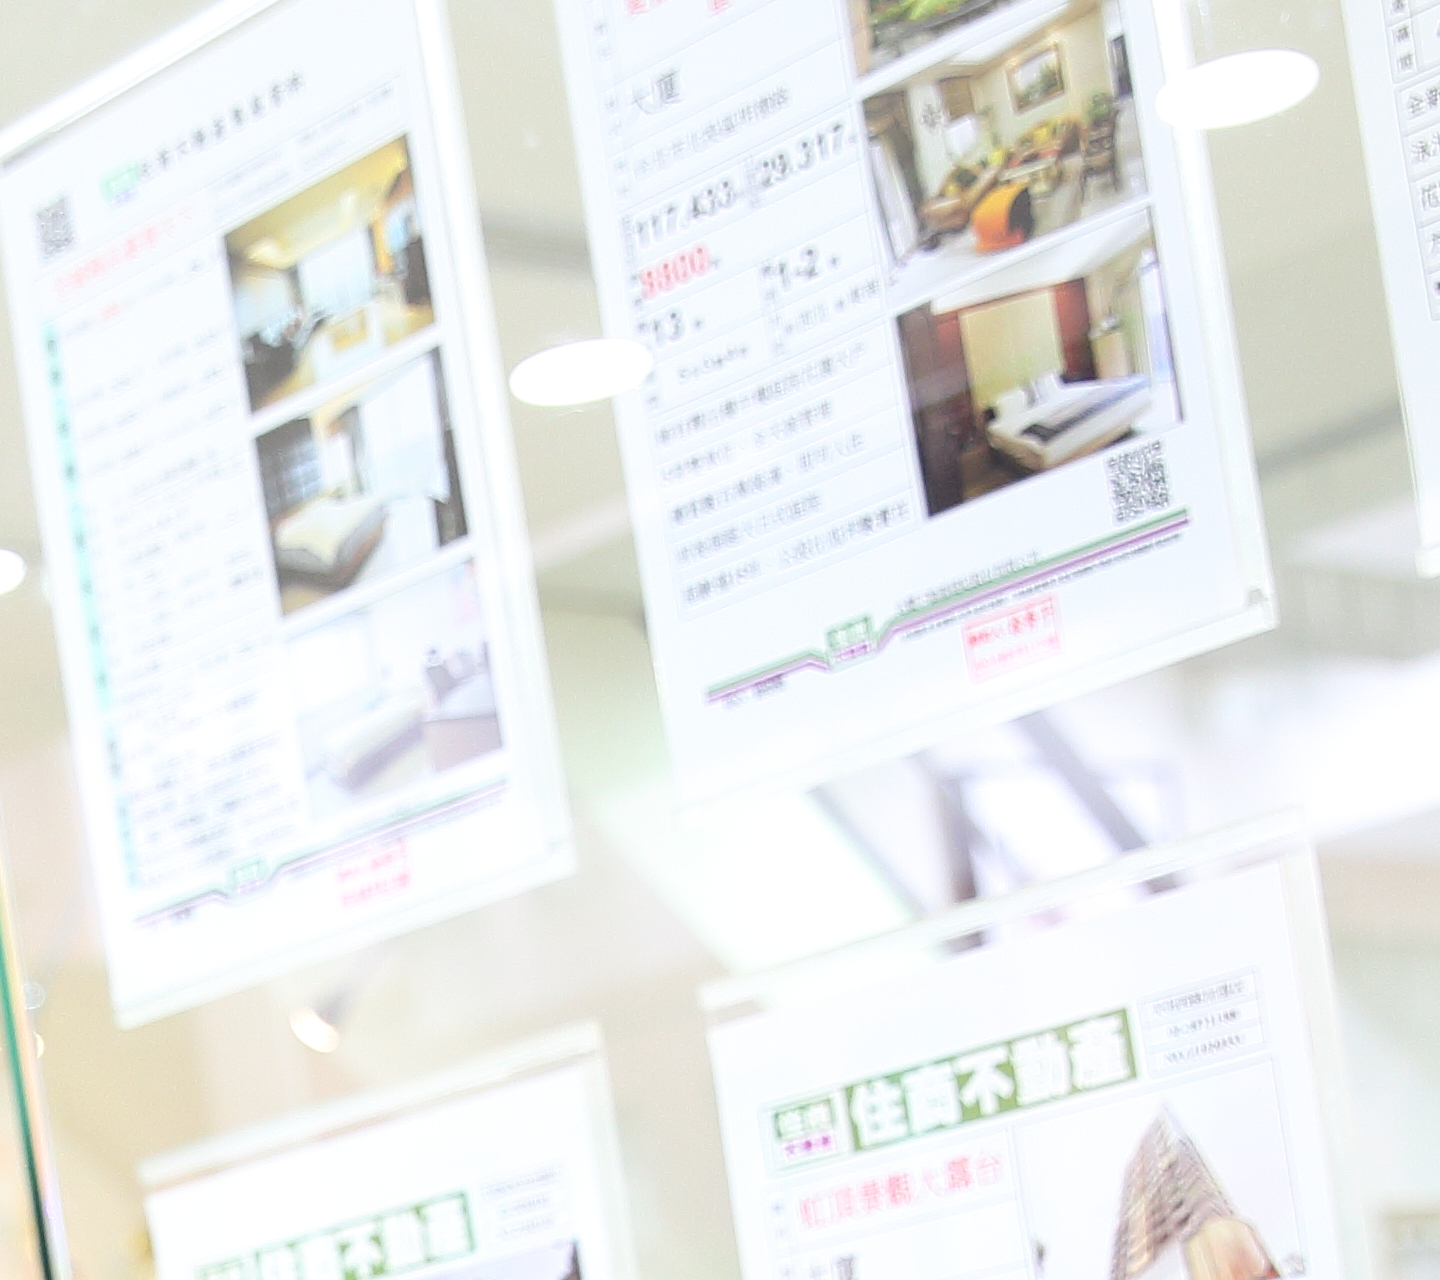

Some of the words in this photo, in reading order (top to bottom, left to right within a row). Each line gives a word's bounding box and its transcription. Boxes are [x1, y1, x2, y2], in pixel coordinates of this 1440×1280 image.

[850, 1013, 1130, 1146] 住商不動產
